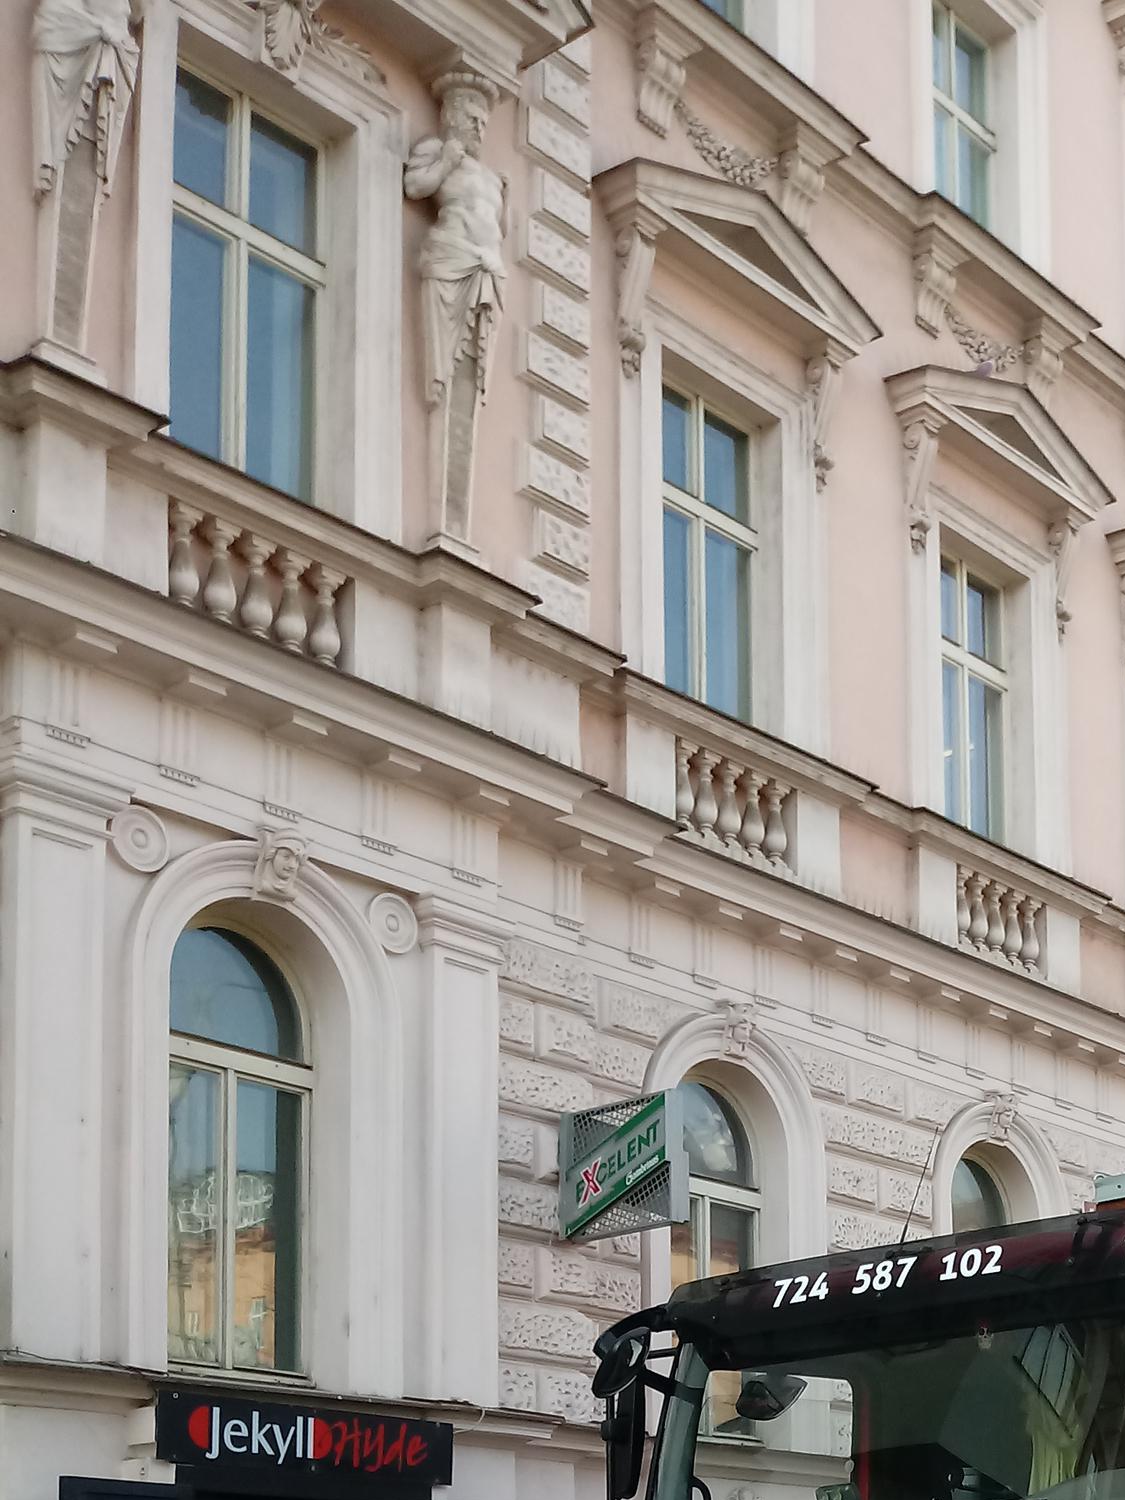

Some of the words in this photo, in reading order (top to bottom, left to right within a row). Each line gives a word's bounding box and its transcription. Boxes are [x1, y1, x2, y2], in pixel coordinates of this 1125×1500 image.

[772, 1271, 830, 1308] 724
[851, 1256, 918, 1294] 587
[939, 1245, 1003, 1281] 102
[205, 1406, 315, 1465] Jekyll
